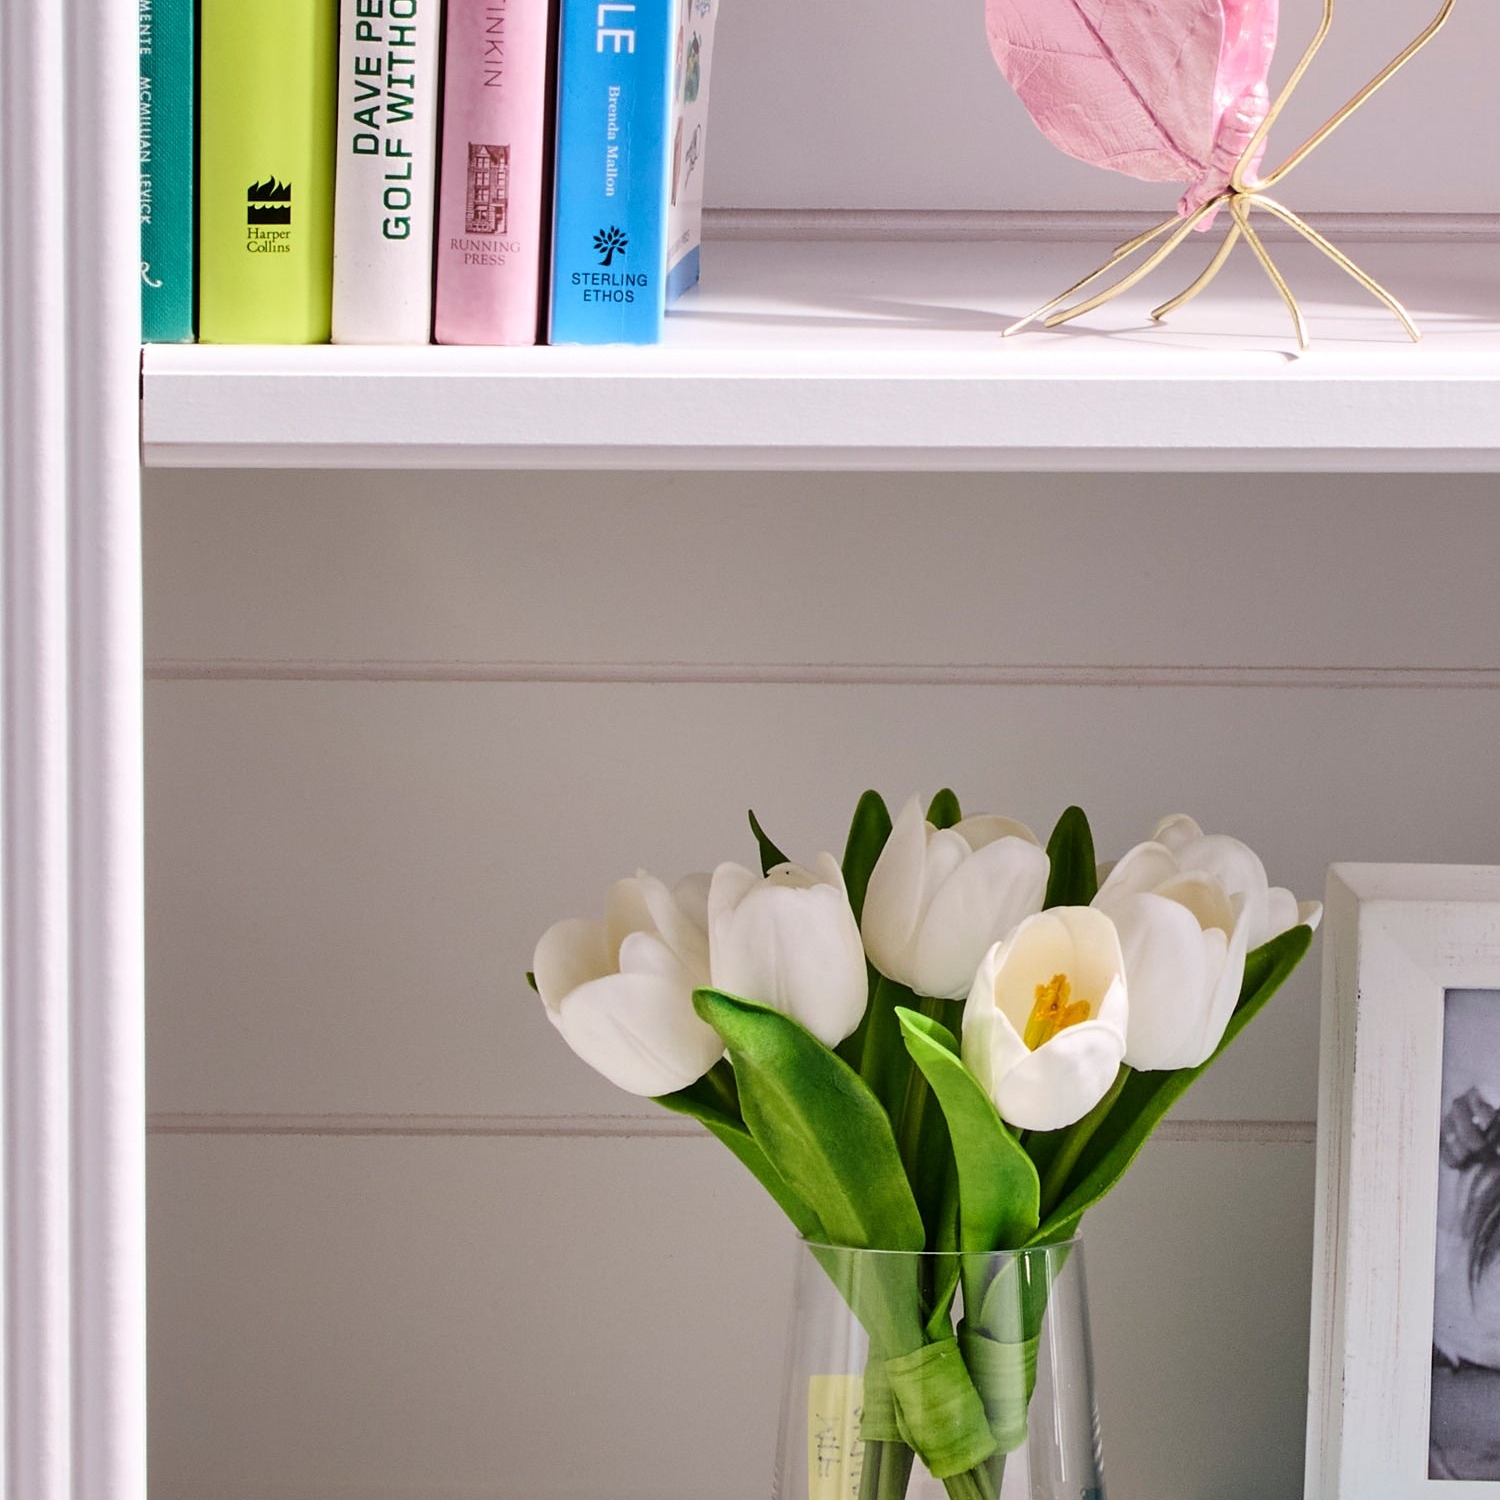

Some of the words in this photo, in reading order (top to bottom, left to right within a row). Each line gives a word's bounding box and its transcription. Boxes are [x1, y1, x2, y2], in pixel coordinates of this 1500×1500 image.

[352, 56, 382, 155] DAVE
[607, 85, 621, 141] Brenda
[605, 145, 619, 197] Mallon
[382, 138, 412, 240] GOLF
[247, 227, 291, 243] Harper
[247, 240, 290, 253] Collins
[450, 239, 520, 254] RUNNING
[464, 252, 506, 265] PRESS
[571, 272, 648, 287] STERLING
[583, 289, 634, 303] ETHOS
